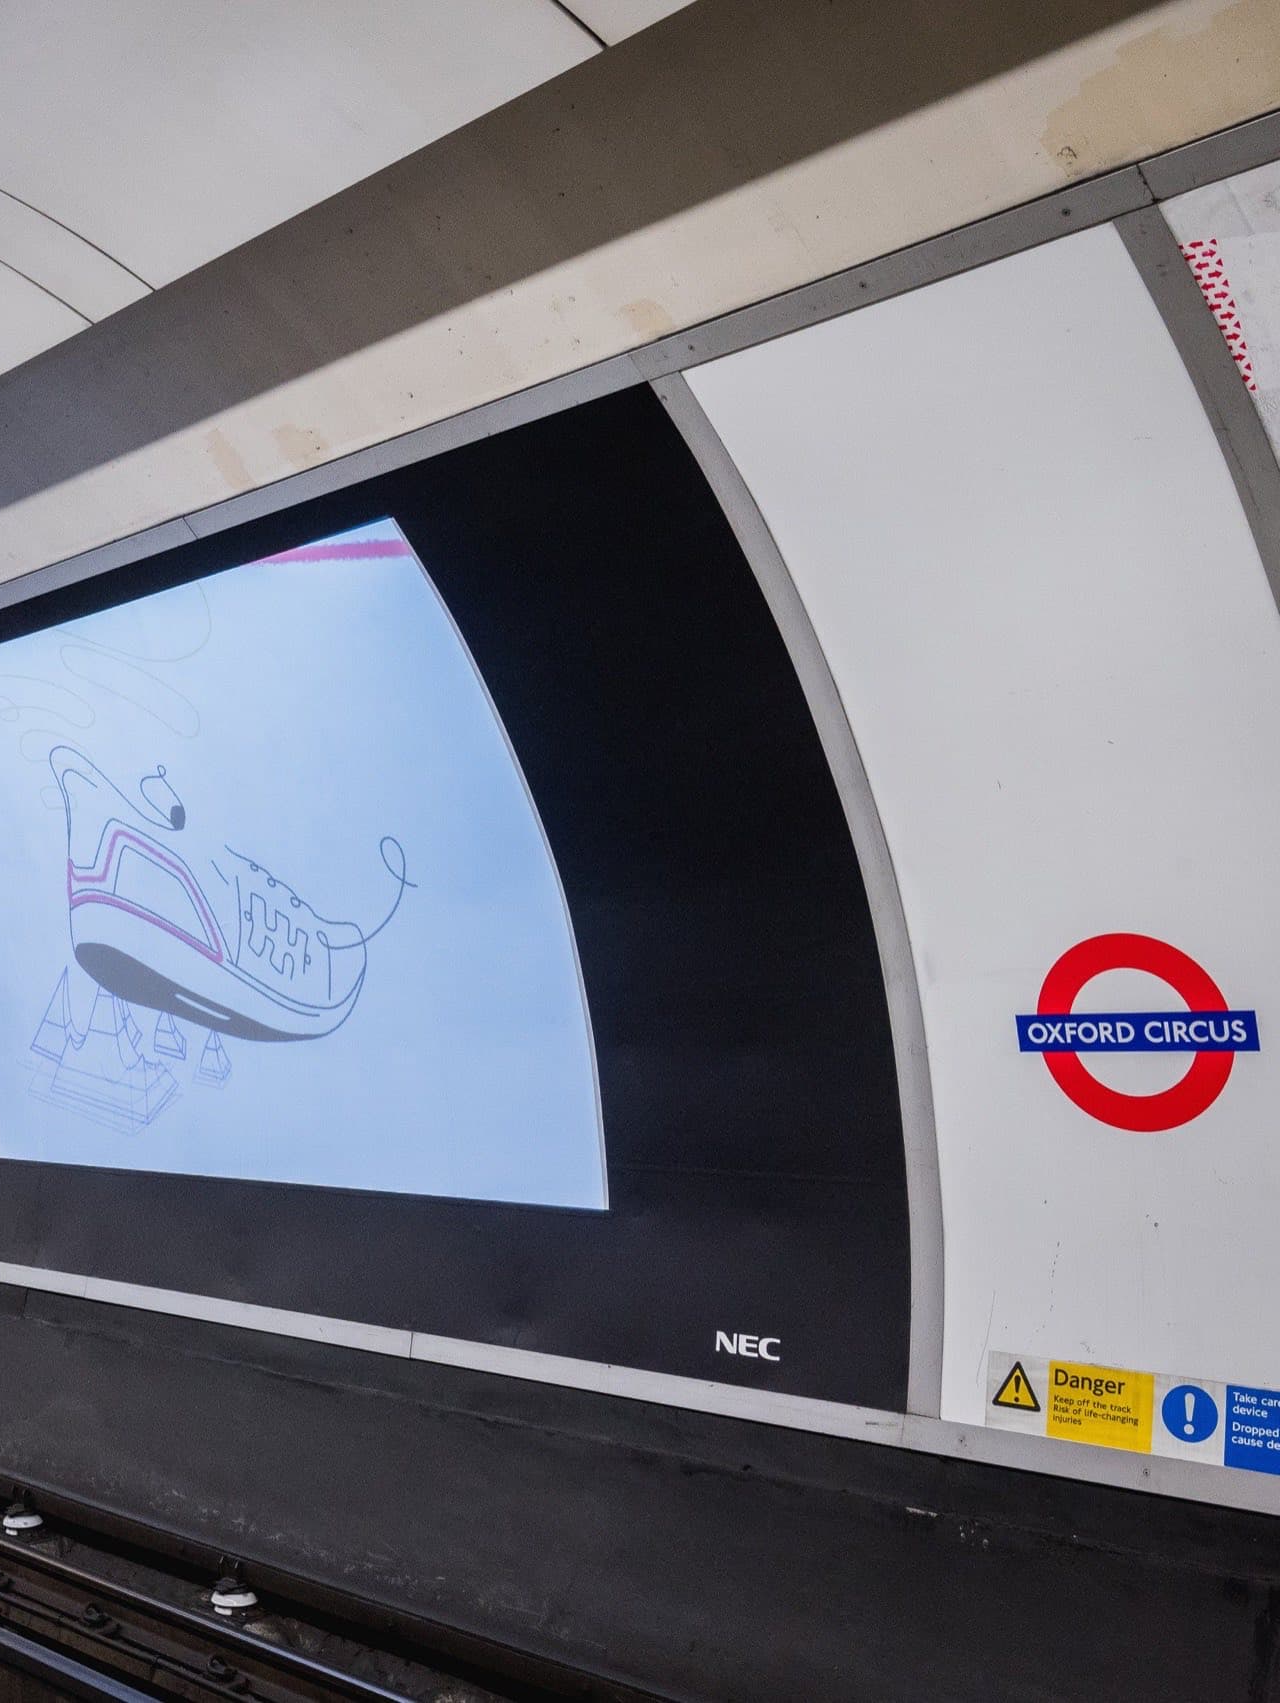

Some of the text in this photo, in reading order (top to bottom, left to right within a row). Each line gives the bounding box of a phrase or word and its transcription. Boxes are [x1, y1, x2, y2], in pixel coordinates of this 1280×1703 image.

[1027, 1020, 1248, 1044] OXFORD CIRCUS
[715, 1330, 781, 1361] NEC
[1054, 1368, 1126, 1397] Danger
[1054, 1395, 1132, 1414] Keep off the track
[1233, 1392, 1257, 1404] Take
[1053, 1404, 1138, 1426] Risk of life-changing
[1053, 1415, 1082, 1425] injuries
[1232, 1405, 1268, 1417] device
[1232, 1421, 1280, 1438] Dropped
[1232, 1436, 1263, 1447] cause
